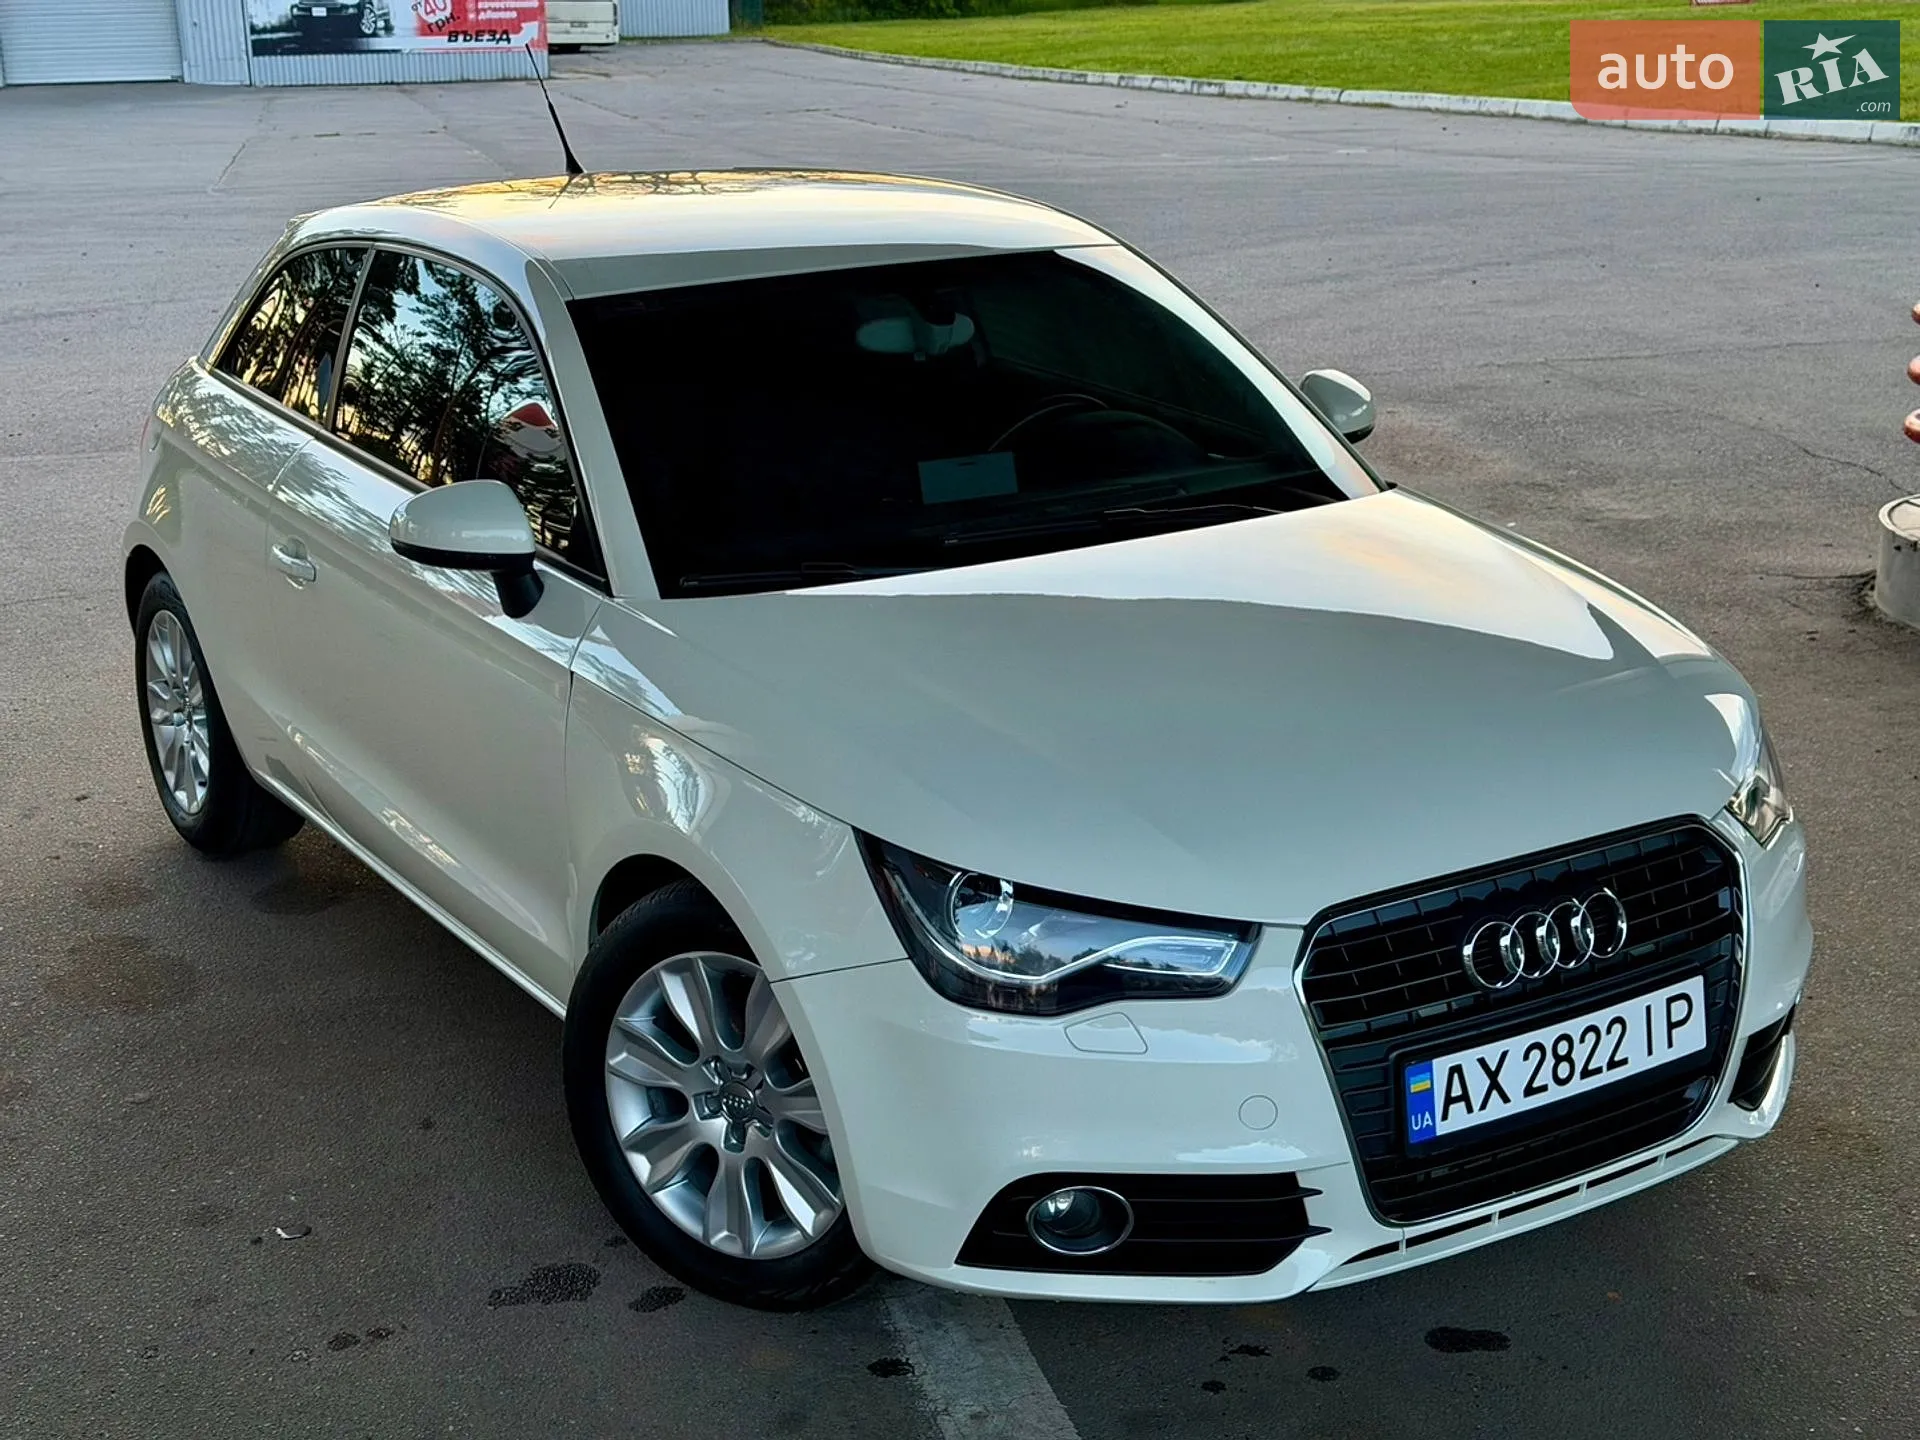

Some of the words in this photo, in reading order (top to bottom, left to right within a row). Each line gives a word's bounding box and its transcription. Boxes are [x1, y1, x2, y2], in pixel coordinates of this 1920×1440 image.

[427, 12, 461, 32] грн.
[447, 30, 512, 44] ВЪЕЗД
[1440, 1049, 1512, 1122] AX
[1522, 1015, 1629, 1099] 2822
[1645, 991, 1694, 1058] IP
[1411, 1113, 1433, 1131] UA
